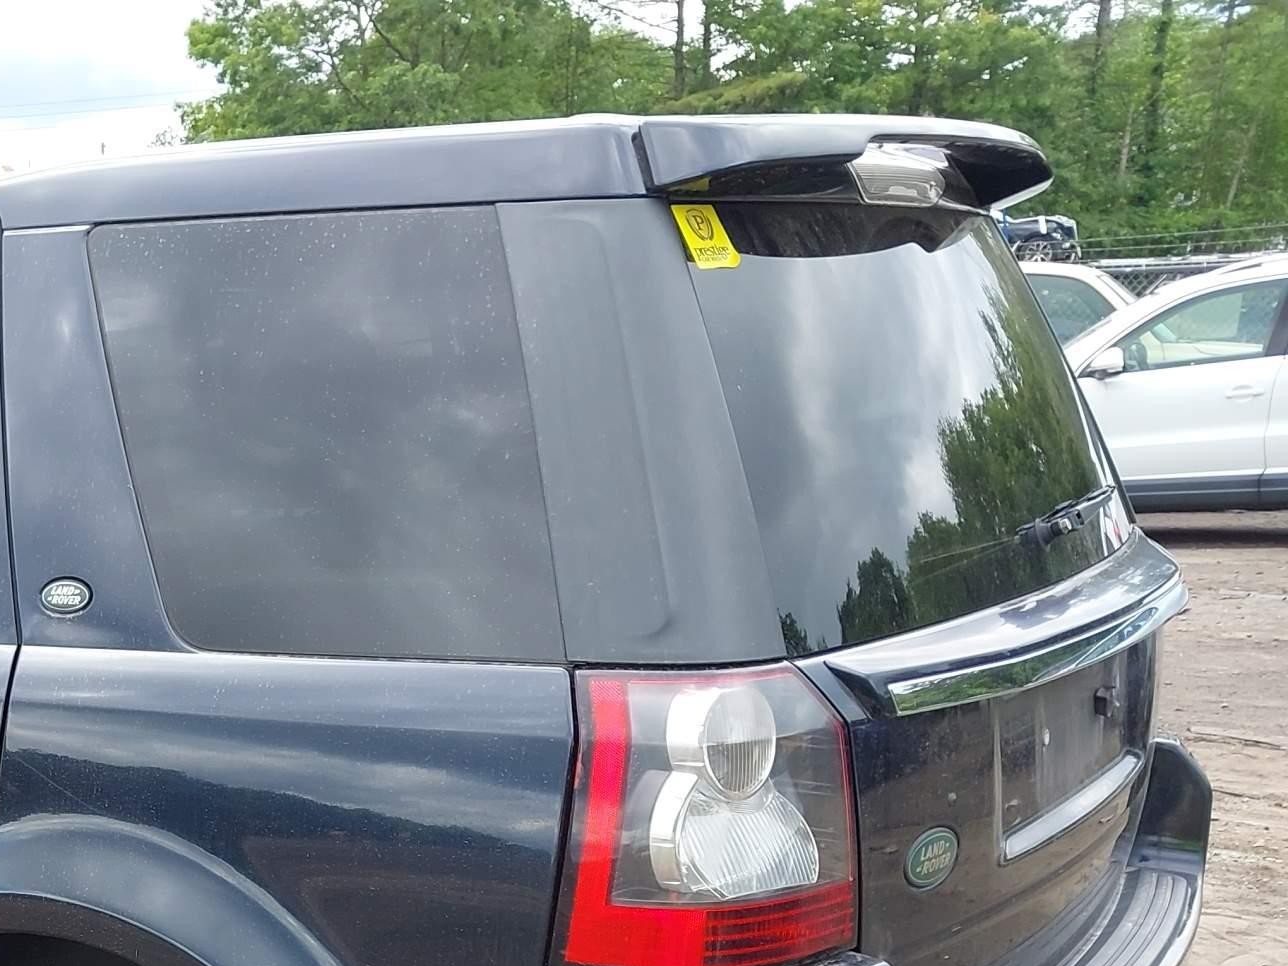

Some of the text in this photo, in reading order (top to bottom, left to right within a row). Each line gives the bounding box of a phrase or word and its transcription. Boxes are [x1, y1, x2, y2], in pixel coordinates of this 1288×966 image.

[51, 585, 75, 595] LAND
[51, 595, 81, 605] ROVER
[920, 840, 945, 861] LAND
[920, 852, 951, 876] ROVER
